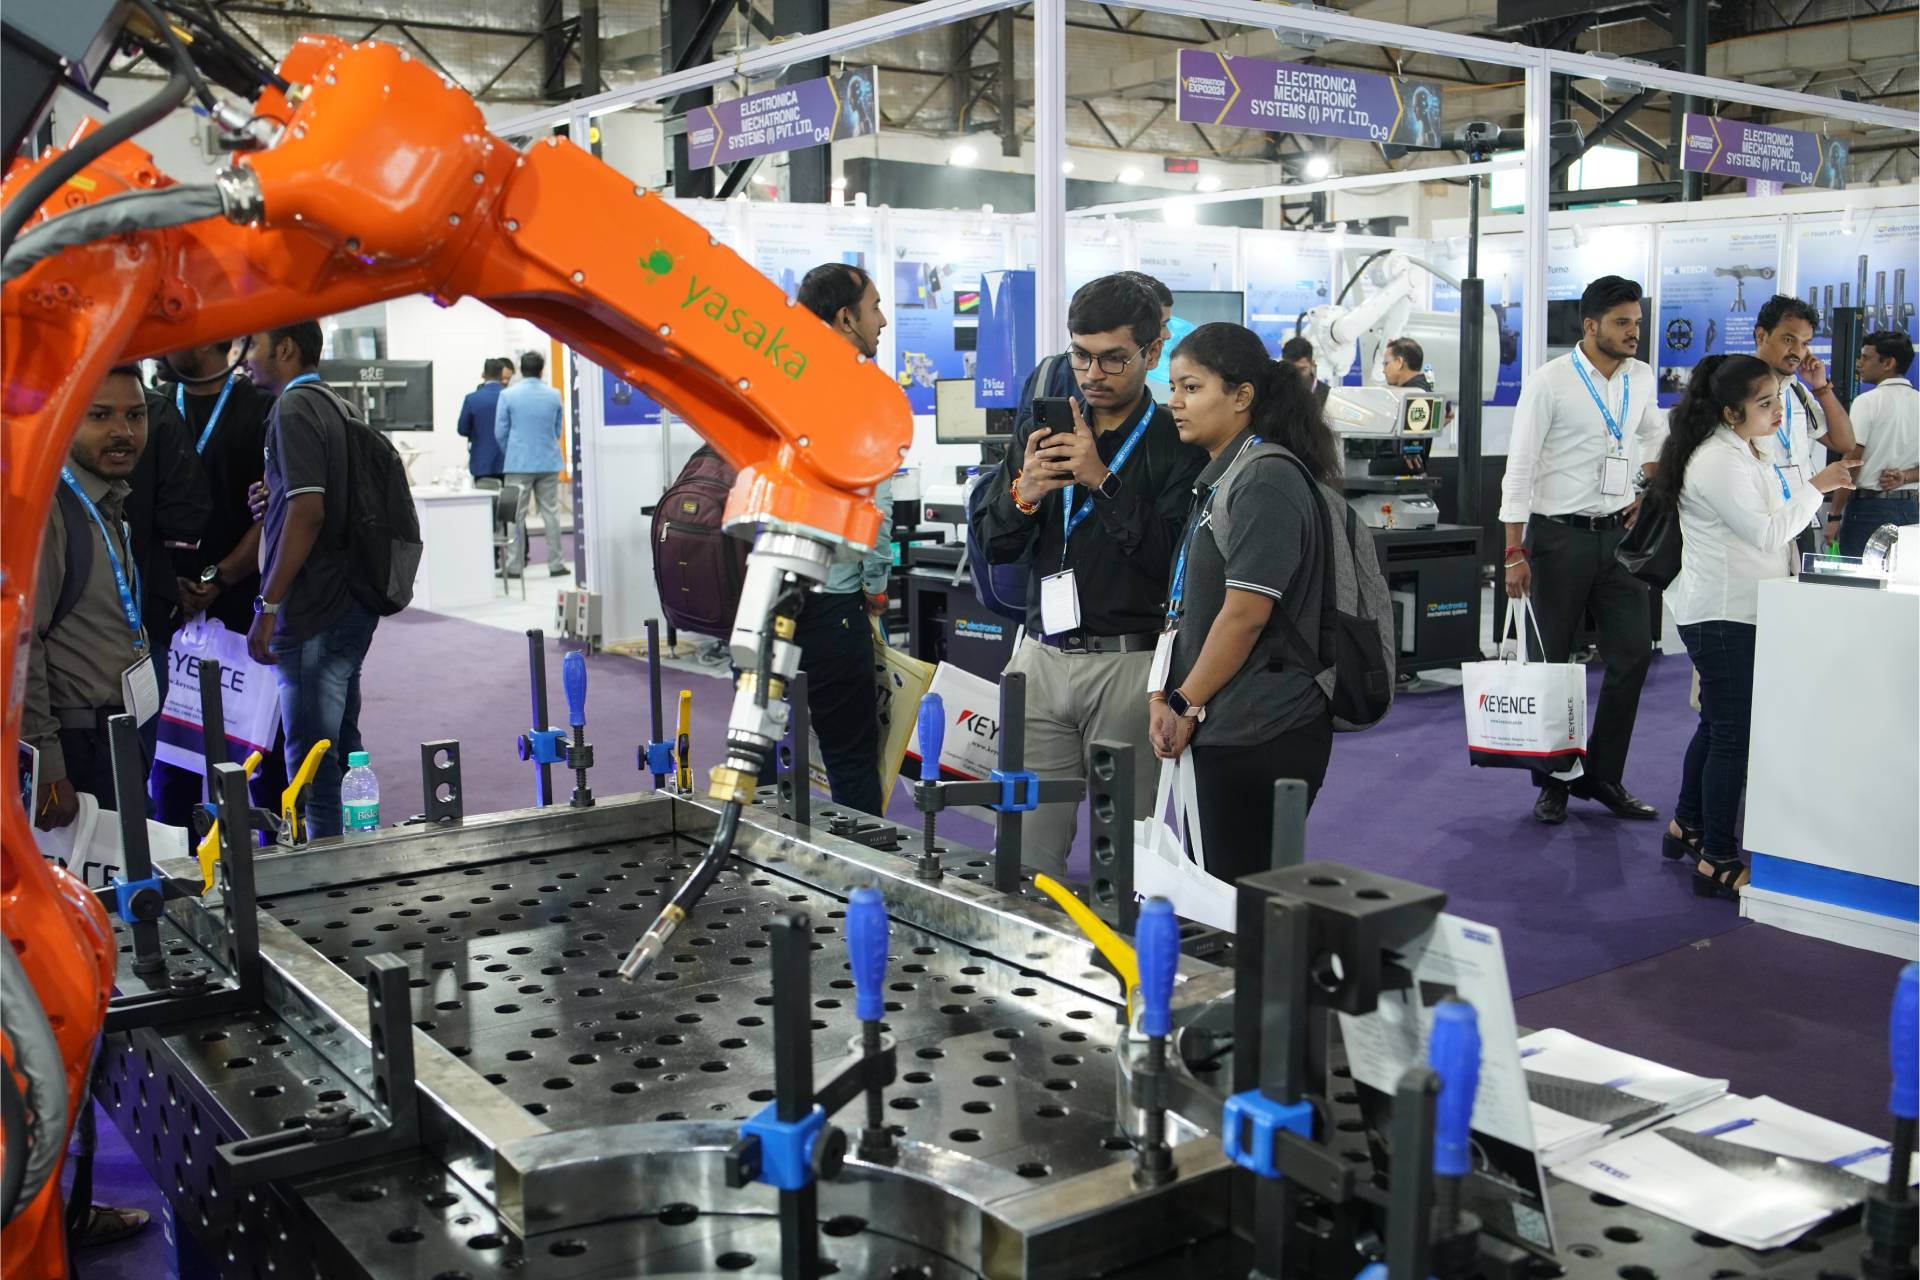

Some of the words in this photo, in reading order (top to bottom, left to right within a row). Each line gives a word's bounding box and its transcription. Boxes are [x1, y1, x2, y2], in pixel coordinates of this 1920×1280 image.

[1276, 69, 1357, 93] ELECTRONICA
[740, 90, 798, 117] ELECTRONICA
[1273, 85, 1357, 108] MECHATRONIC
[740, 106, 801, 132] MECHATRONIC
[1250, 100, 1306, 119] SYSTEMS
[1308, 104, 1320, 125] (I)
[1322, 107, 1347, 124] PVT.
[1348, 111, 1371, 128] LTD.
[728, 131, 767, 150] SYSTEMS
[766, 130, 776, 146] (I)
[776, 125, 796, 143] PVT.
[795, 120, 813, 137] LTD.
[1743, 128, 1794, 147] ELECTRONICA
[1741, 140, 1794, 159] MECHATRONIC
[1726, 152, 1761, 169] SYSTEMS
[1769, 157, 1786, 172] PVT.
[1787, 160, 1801, 174] LTD.
[680, 275, 808, 381] yasaka
[967, 621, 1003, 633] electronica
[1479, 694, 1536, 714] KEYENCE
